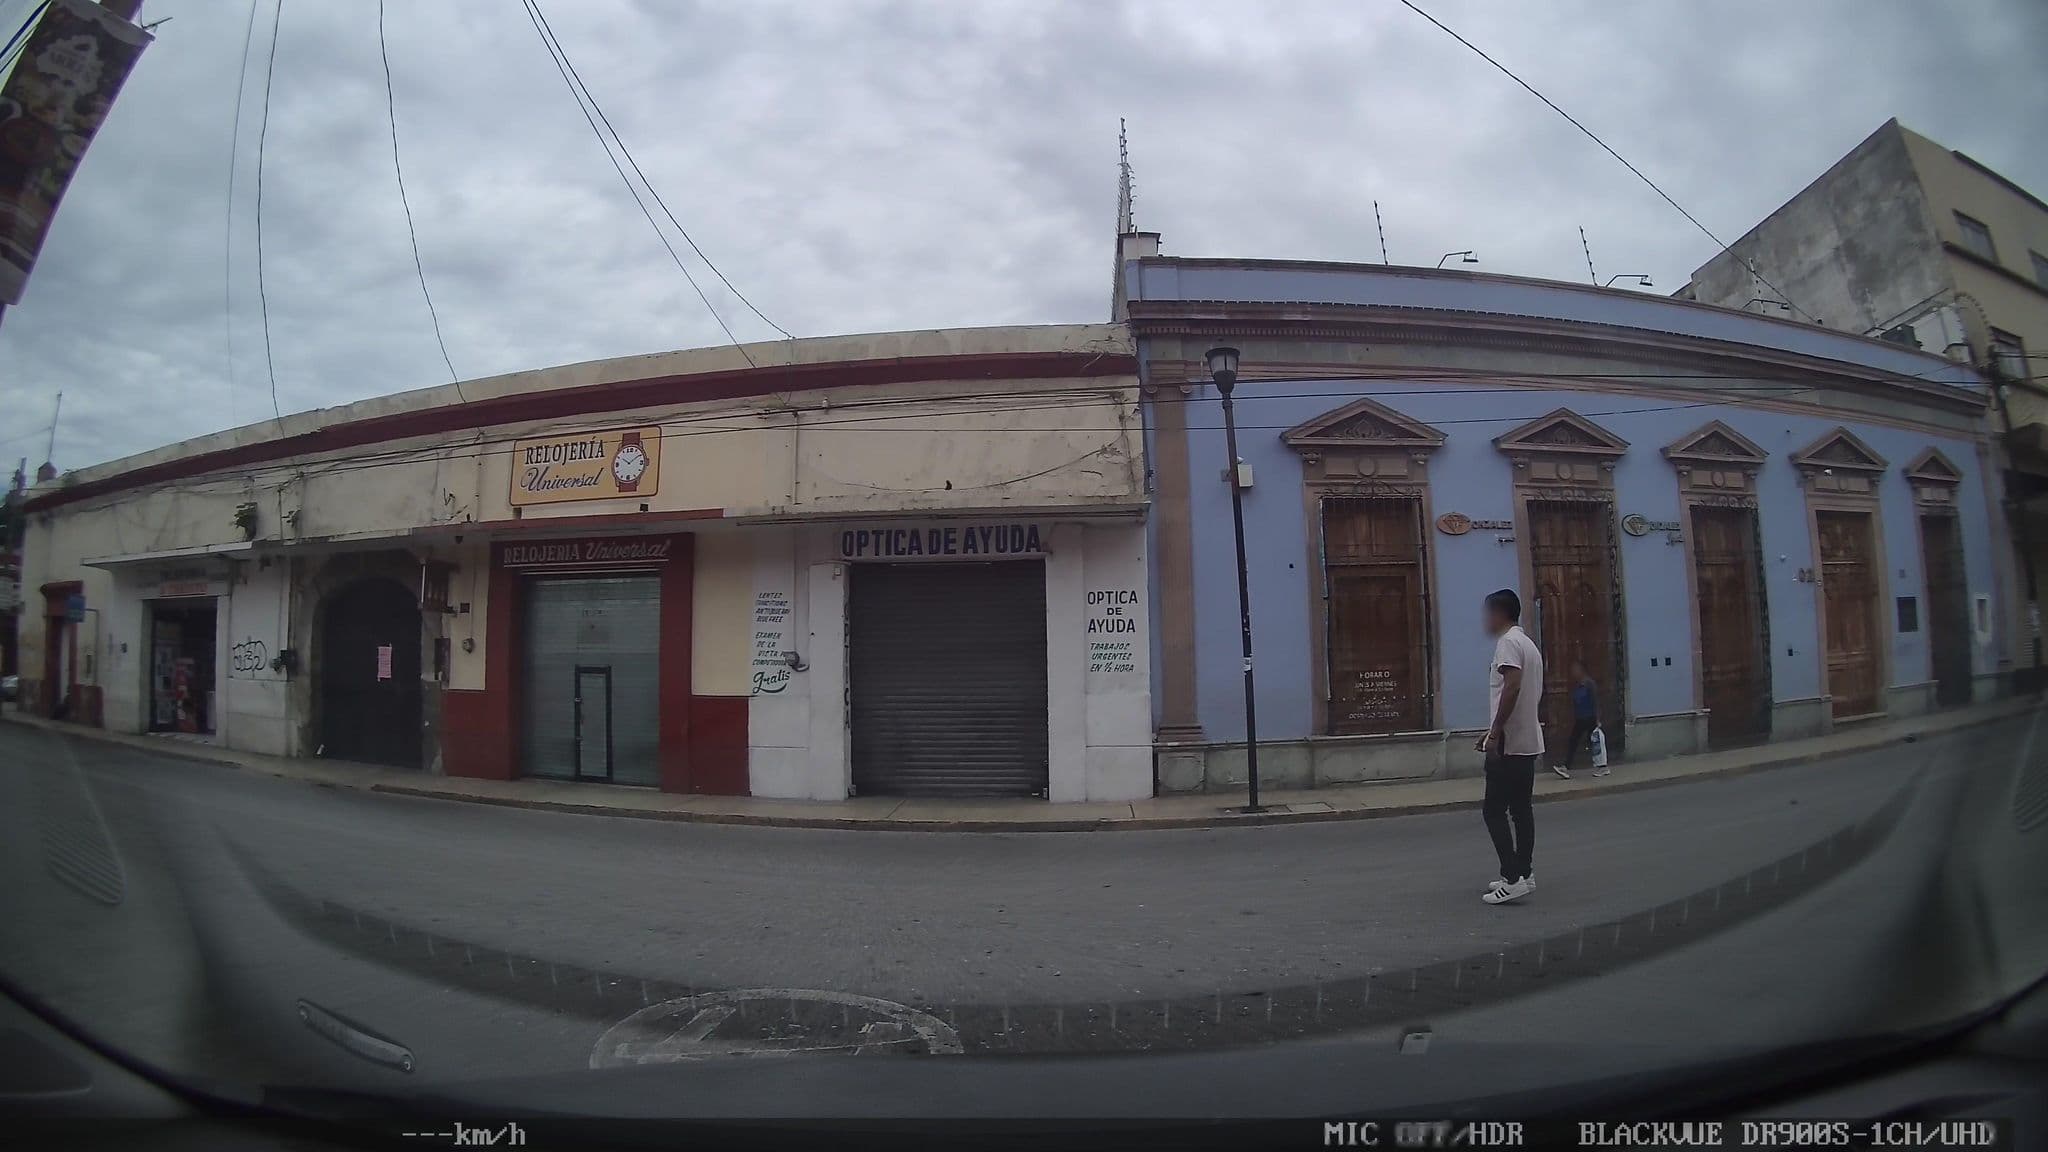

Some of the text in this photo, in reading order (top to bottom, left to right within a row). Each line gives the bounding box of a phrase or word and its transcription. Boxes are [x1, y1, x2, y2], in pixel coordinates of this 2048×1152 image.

[525, 436, 605, 465] RELOJERÍA
[520, 466, 604, 491] Universal
[842, 524, 1041, 556] OPTICA DE AYUDA
[504, 538, 672, 563] RELOJERIA Universal
[1087, 590, 1138, 605] OPTICA
[1106, 607, 1123, 616] DE
[1088, 618, 1136, 633] AYUDA
[755, 631, 782, 640] EXAMEN
[1090, 642, 1131, 650] TRABAJOS
[1091, 652, 1133, 660] URGENTES
[1090, 663, 1103, 672] EN
[1113, 664, 1135, 673] HORA
[752, 669, 791, 694] Gratis
